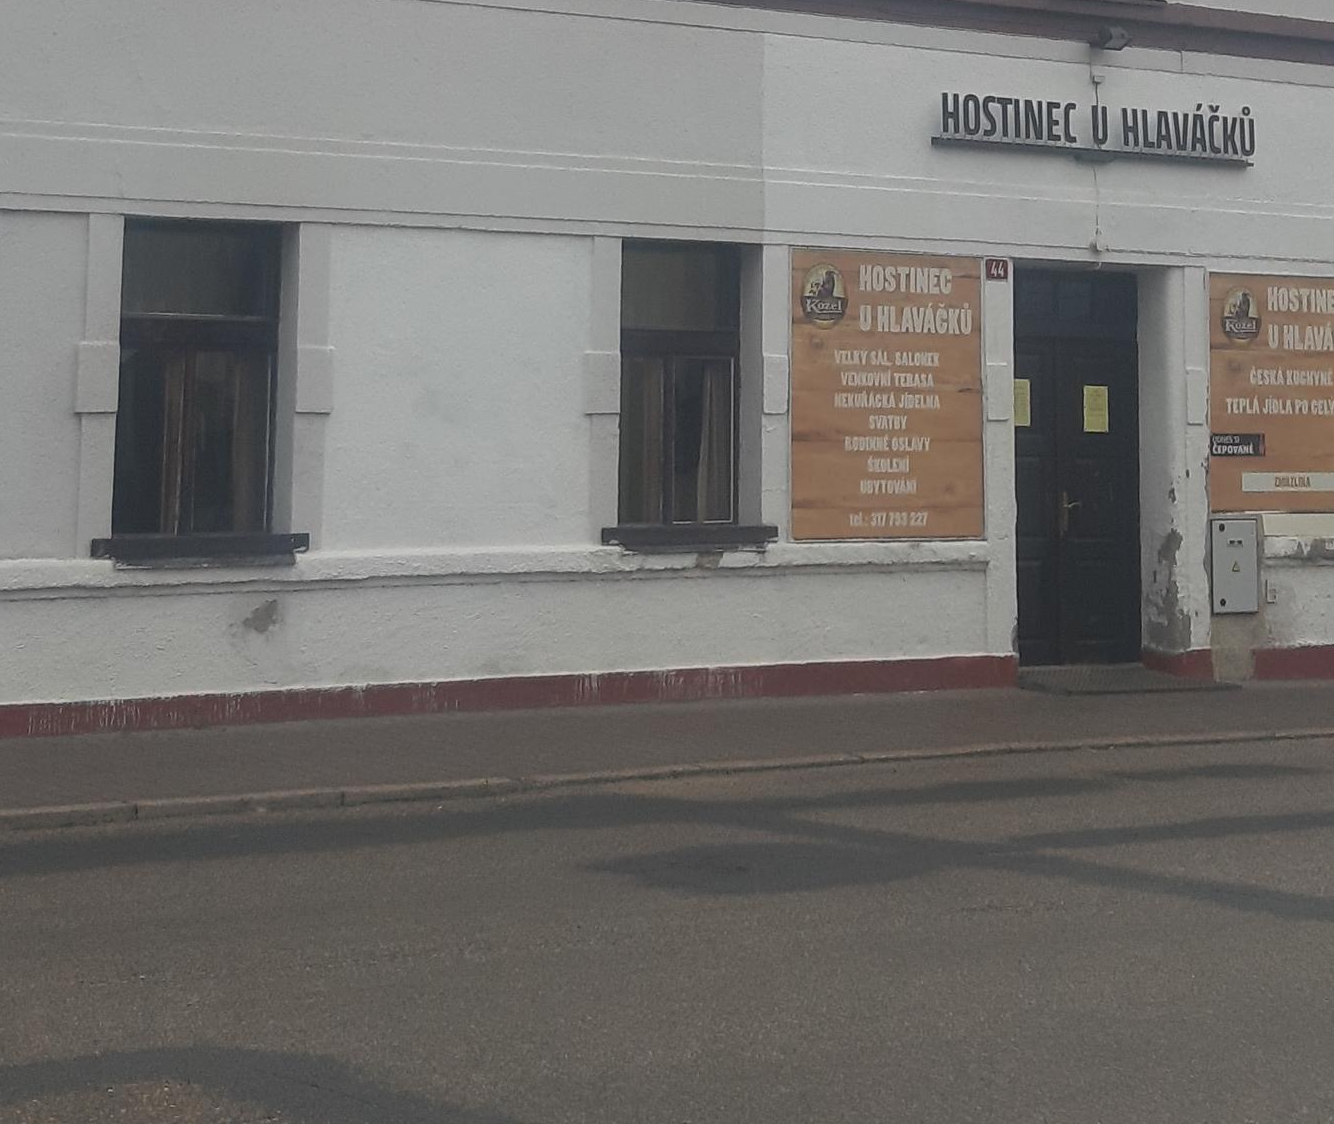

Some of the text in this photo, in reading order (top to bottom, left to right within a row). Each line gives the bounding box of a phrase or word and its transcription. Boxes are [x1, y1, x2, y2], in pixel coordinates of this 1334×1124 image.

[941, 92, 1256, 157] HOSTINEC U HLAVÁČKŮ
[991, 260, 1005, 277] 44
[859, 265, 952, 295] HOSTINEC
[805, 299, 843, 315] Kozel
[860, 302, 973, 335] U HLAVÁČKŮ
[1225, 319, 1258, 332] Kozel
[1268, 325, 1279, 349] U
[894, 373, 935, 388] TERASA
[1250, 367, 1284, 386] ČESKÁ
[1226, 396, 1260, 414] TEPLÁ
[1262, 396, 1293, 415] JÍDLA
[1295, 399, 1309, 414] PO
[869, 414, 908, 430] SVATBY
[891, 436, 931, 452] OSLAVY
